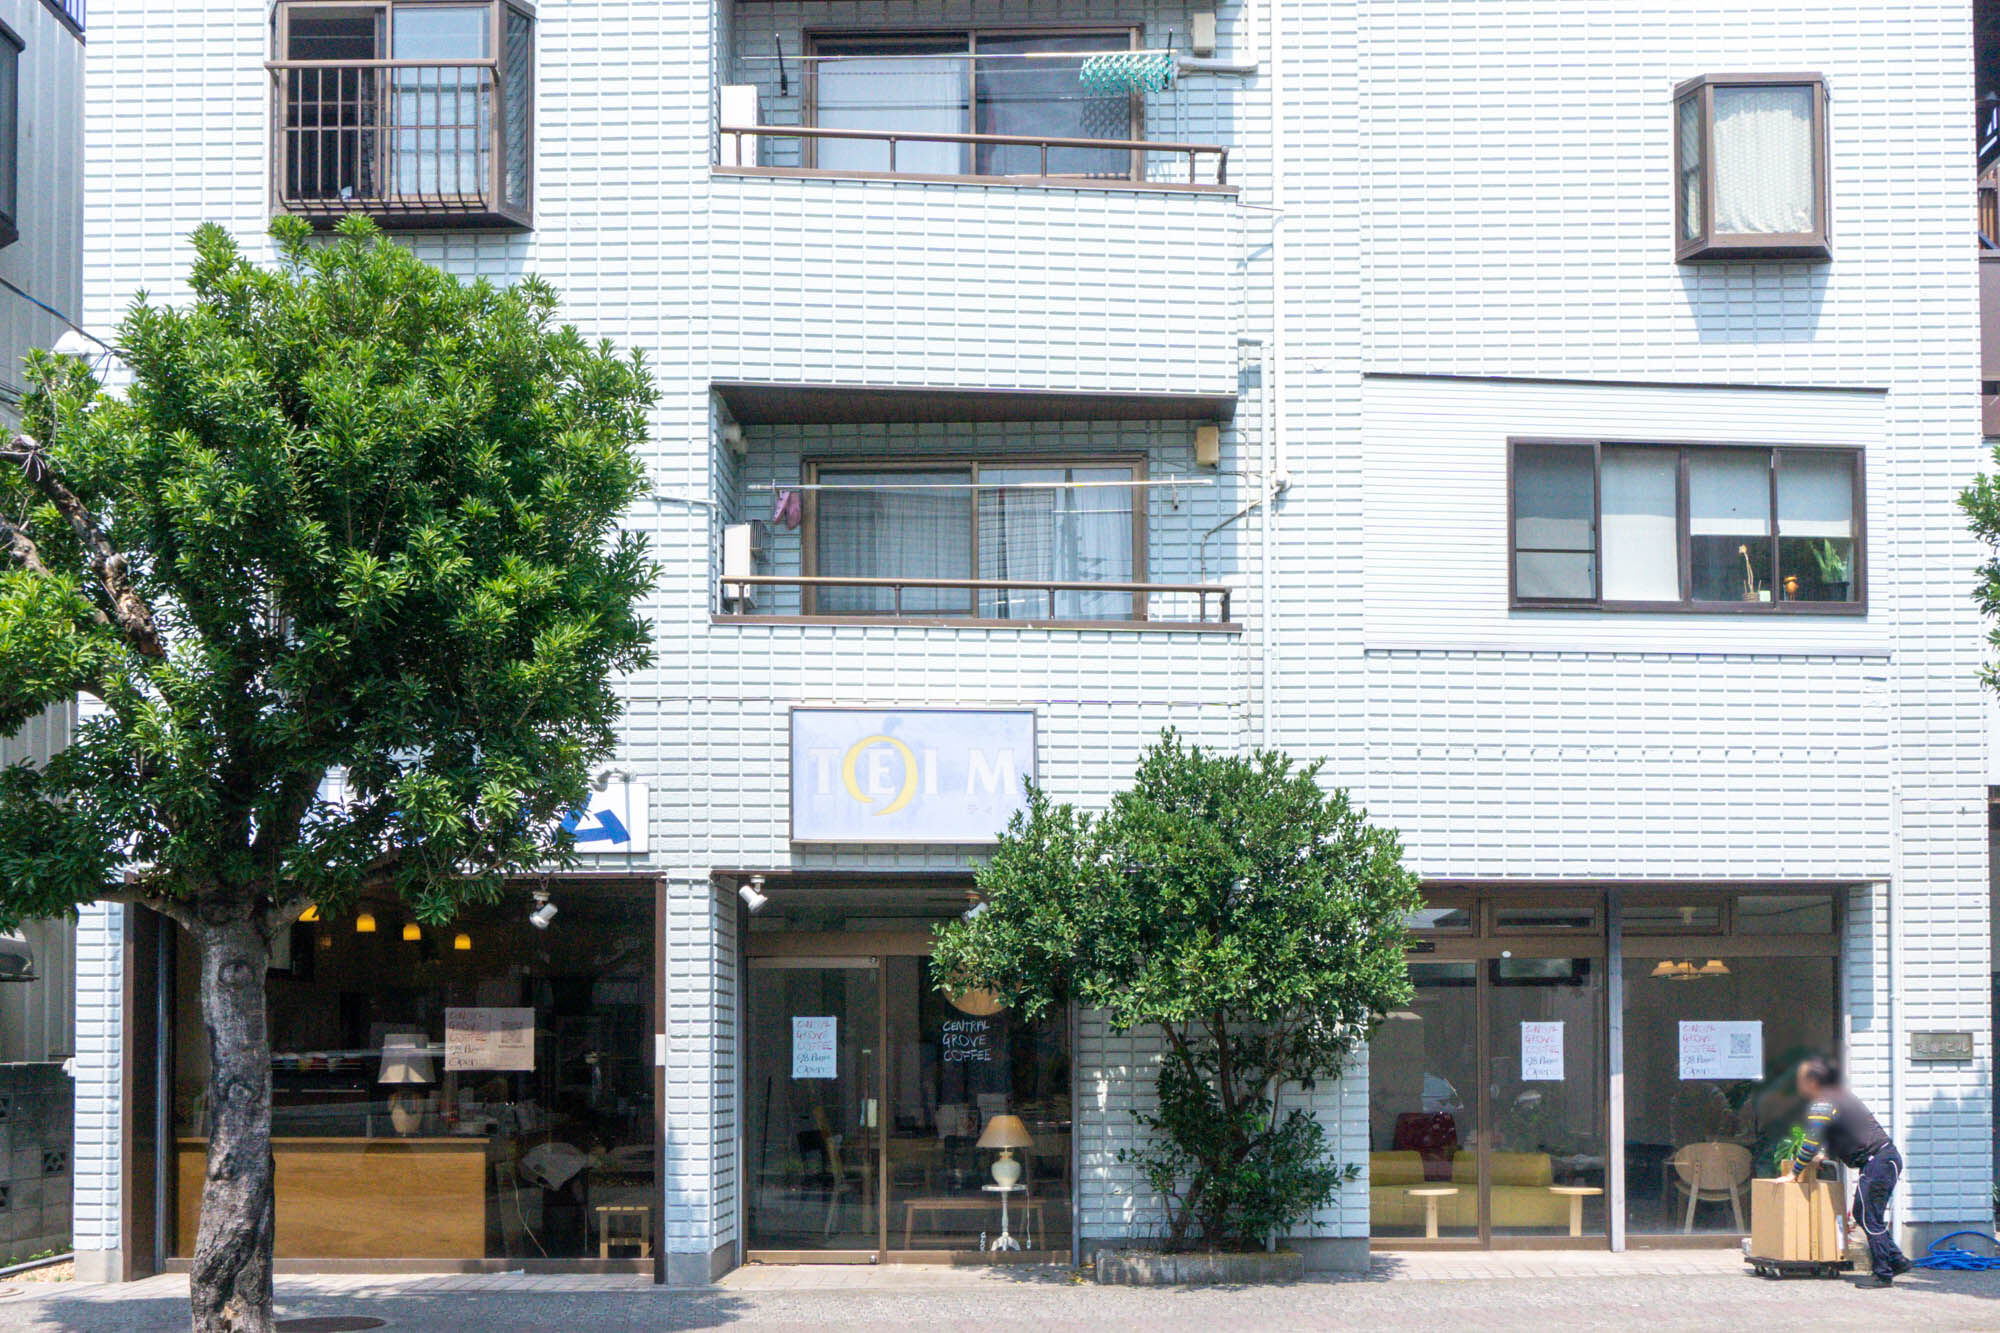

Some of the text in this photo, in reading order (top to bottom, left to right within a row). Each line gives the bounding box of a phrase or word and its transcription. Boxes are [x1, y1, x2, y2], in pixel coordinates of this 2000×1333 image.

[942, 1019, 991, 1033] CENTRAL
[942, 1033, 987, 1048] GROVE
[943, 1048, 993, 1062] COFFEE
